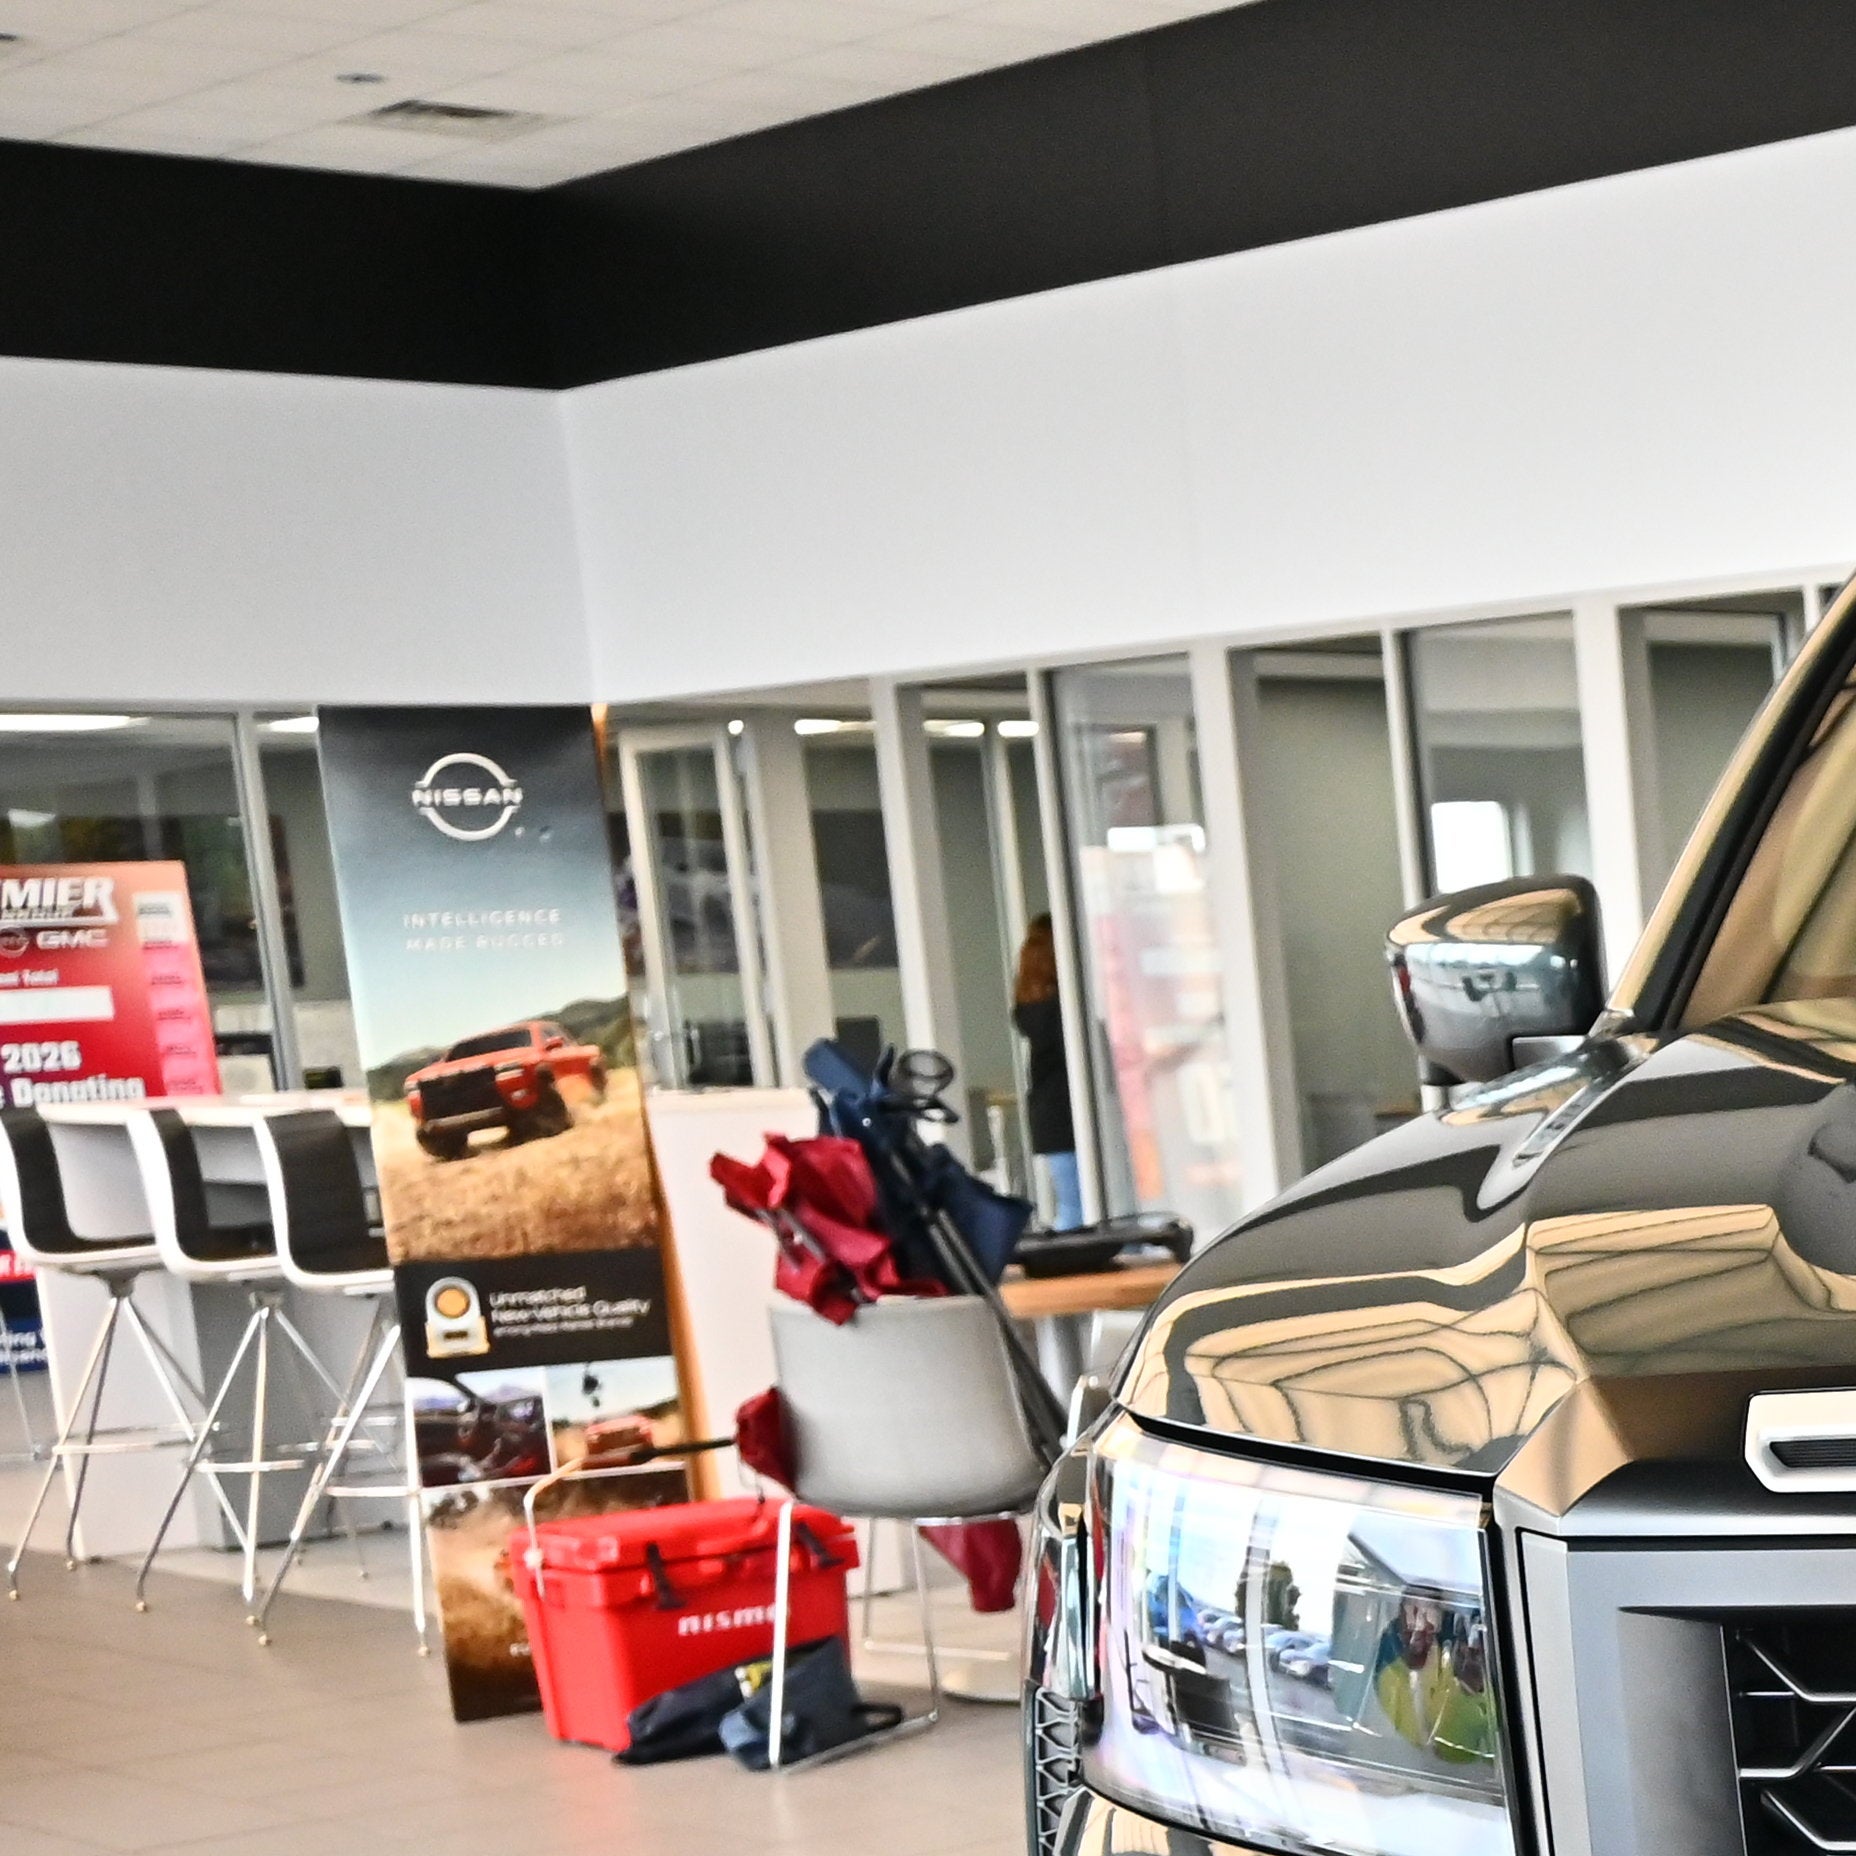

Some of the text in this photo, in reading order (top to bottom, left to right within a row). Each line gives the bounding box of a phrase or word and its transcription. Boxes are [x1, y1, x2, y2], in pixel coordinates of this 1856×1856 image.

[411, 787, 524, 807] NISSAN
[0, 876, 115, 910] MIER
[404, 908, 561, 928] INTELLIGENCE
[36, 929, 108, 950] GMC
[1, 1040, 82, 1074] 2026
[10, 1073, 147, 1108] Donating
[593, 1298, 651, 1317] Quality
